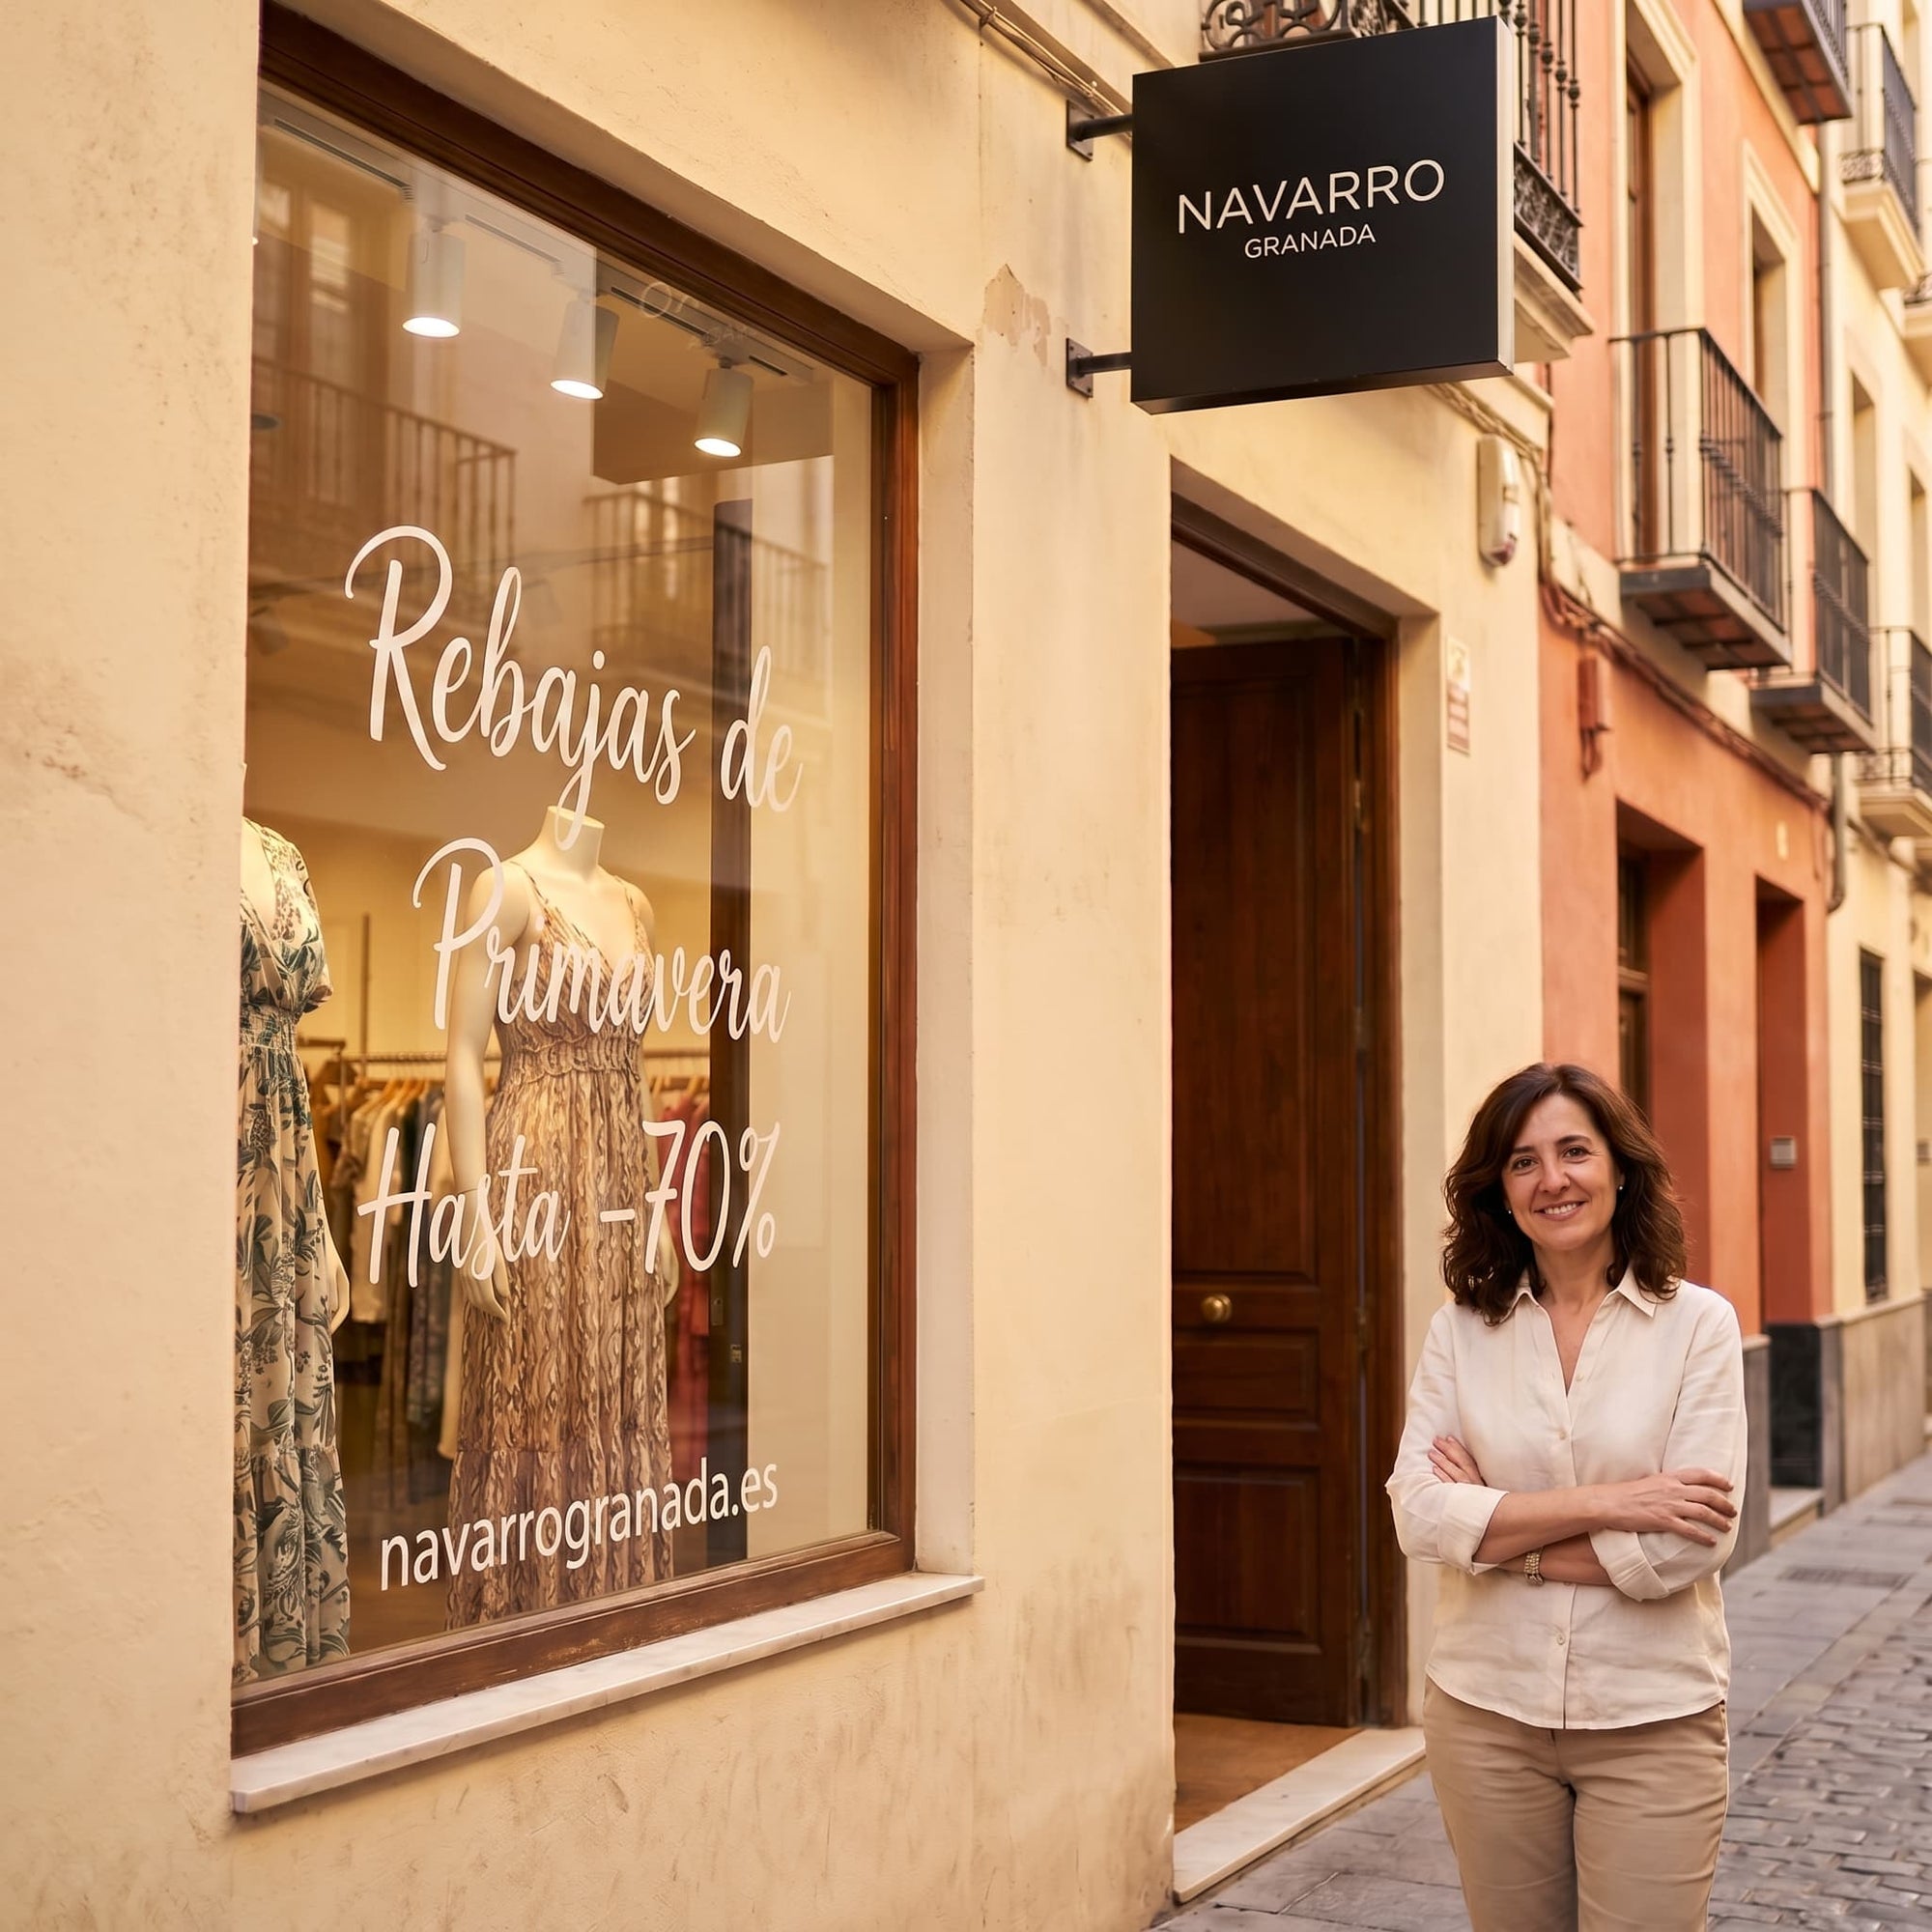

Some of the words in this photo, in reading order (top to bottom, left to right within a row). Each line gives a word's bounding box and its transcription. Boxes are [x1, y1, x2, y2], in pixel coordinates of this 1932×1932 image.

[1178, 158, 1445, 235] NAVARRO
[1244, 223, 1376, 259] GRANADA
[345, 525, 696, 851] Rebajas
[720, 645, 803, 812] de
[412, 837, 792, 1043] Primavera
[357, 1122, 571, 1288] Hasta
[599, 1119, 781, 1274] -70%
[381, 1456, 779, 1591] navarrogranada.es
